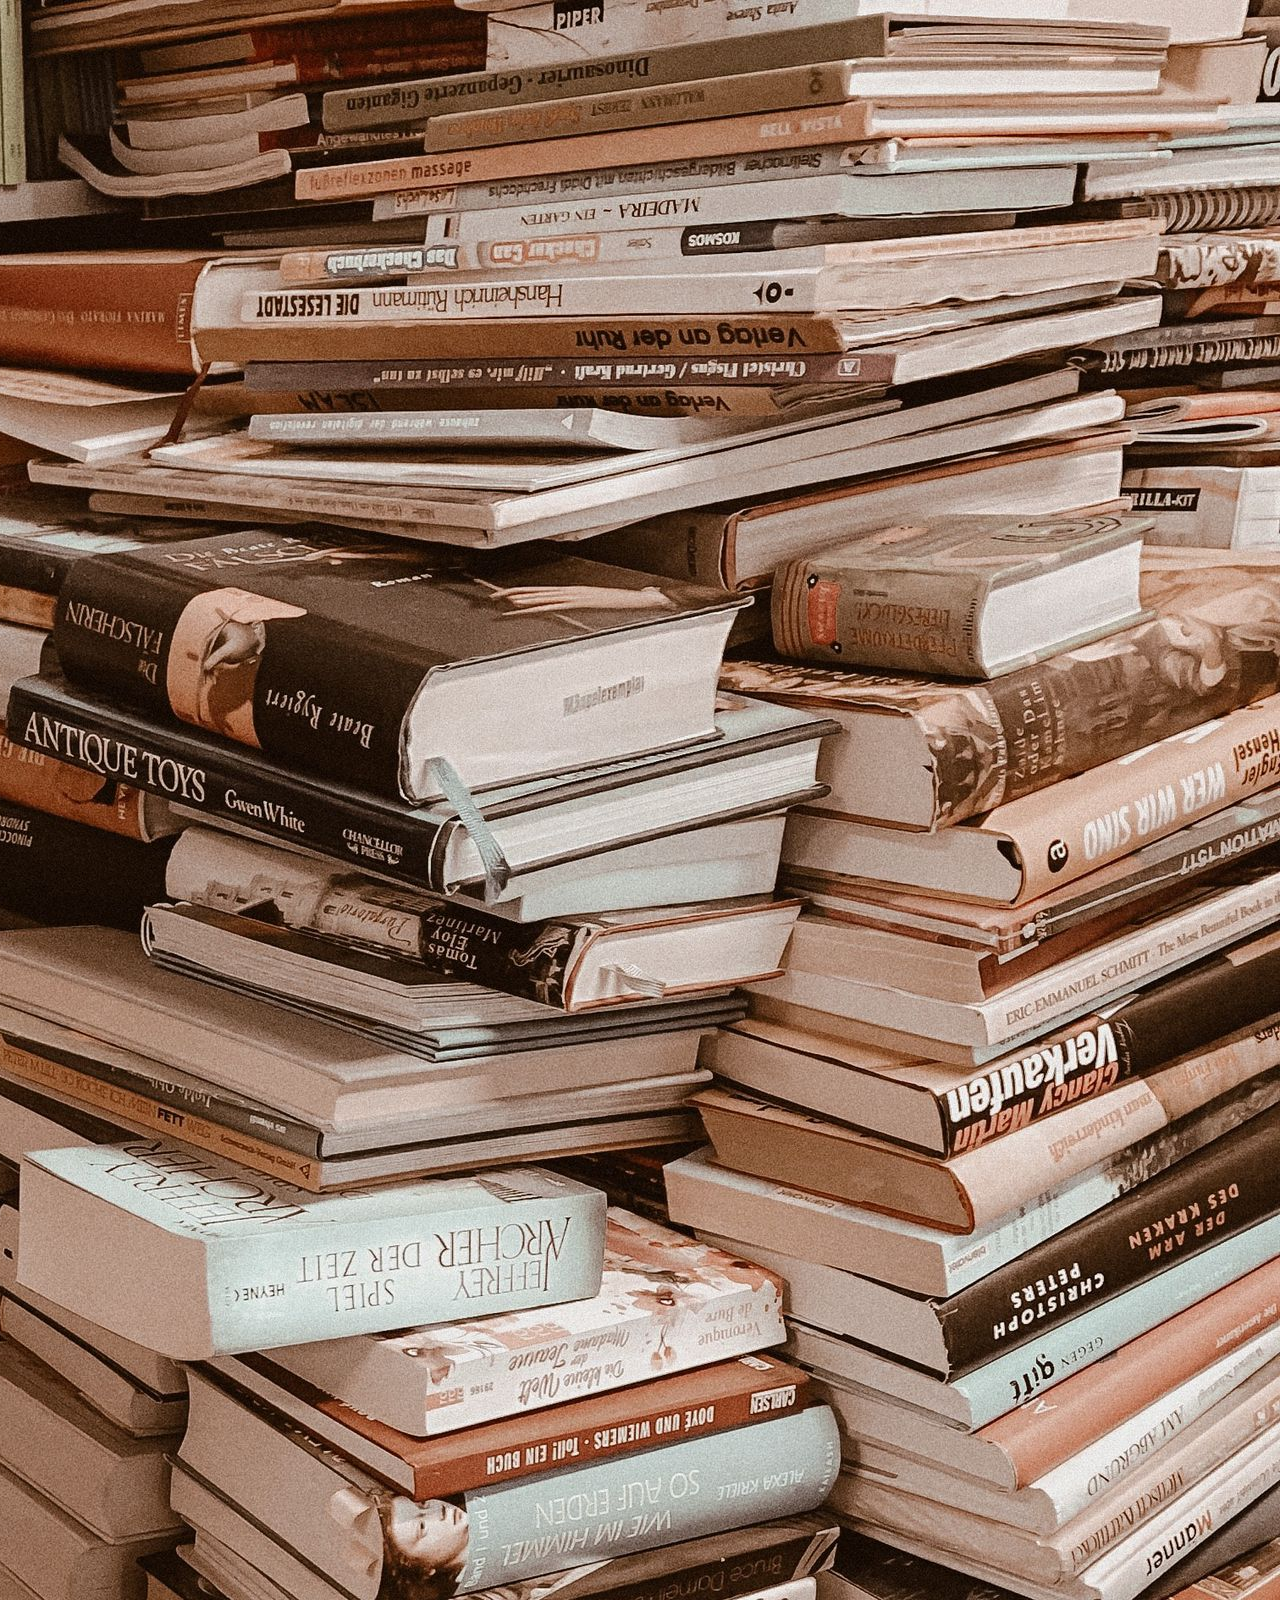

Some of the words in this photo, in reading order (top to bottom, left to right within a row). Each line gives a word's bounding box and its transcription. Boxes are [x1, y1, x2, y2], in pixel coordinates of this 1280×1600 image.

[556, 6, 601, 30] PIPER
[537, 56, 650, 89] Dinosaurier
[346, 86, 420, 112] Giganten
[424, 72, 523, 104] Gepanzerte
[411, 160, 472, 180] massage
[520, 210, 571, 226] GARTEN
[577, 208, 596, 221] EIN
[619, 196, 701, 218] MADEIRA
[688, 231, 740, 247] KOSMOS
[257, 294, 332, 318] LESESTADT
[336, 293, 360, 316] DIE
[453, 283, 563, 311] Hansheinrich
[575, 329, 625, 350] Ruhr
[632, 325, 671, 346] der
[679, 327, 712, 345] an
[717, 322, 807, 349] Verlag
[668, 390, 731, 412] Verlag
[266, 689, 324, 730] Rygiert
[329, 712, 375, 749] Beate
[24, 711, 137, 779] ANTIQUE
[141, 751, 206, 803] TOYS
[1183, 760, 1226, 813] WER
[225, 789, 262, 820] Gwen
[262, 797, 306, 834] White
[1137, 784, 1177, 833] WIR
[1083, 805, 1132, 861] SIND
[430, 926, 468, 951] Eloy
[1005, 973, 1101, 1027] ERIC-EMMANUEL
[1101, 949, 1151, 983] SCHMITT
[1158, 938, 1177, 958] The
[946, 1022, 1120, 1124] Verkaufen
[1039, 1060, 1119, 1115] Clancy
[156, 1107, 186, 1128] FETT
[953, 1098, 1034, 1151] Martin
[1206, 1183, 1240, 1209] DES
[1128, 1202, 1201, 1250] KRAKEN
[1197, 1210, 1225, 1236] DER
[371, 1240, 421, 1275] DER
[434, 1216, 572, 1269] ARCHER
[1148, 1232, 1185, 1261] ARM
[297, 1250, 358, 1285] ZEIT
[453, 1245, 551, 1301] JEFFREY
[327, 1277, 396, 1313] SPIEL
[1010, 1261, 1080, 1309] PETERS
[993, 1272, 1106, 1340] CHRISTOPH
[1059, 1335, 1104, 1370] GEGEN
[1009, 1353, 1056, 1400] gift
[750, 1386, 796, 1415] CARLSEN
[594, 1420, 652, 1449] WIEMERS
[655, 1413, 681, 1435] UND
[486, 1451, 522, 1476] BUCH
[525, 1445, 548, 1466] EIN
[1086, 1428, 1156, 1497] ABGRUND
[610, 1476, 664, 1515] AUF
[670, 1469, 700, 1494] SO
[535, 1490, 608, 1530] ERDEN
[620, 1509, 672, 1537] WIE
[501, 1524, 589, 1567] HIMMEL
[592, 1519, 618, 1545] IM
[1145, 1509, 1213, 1578] Männer
